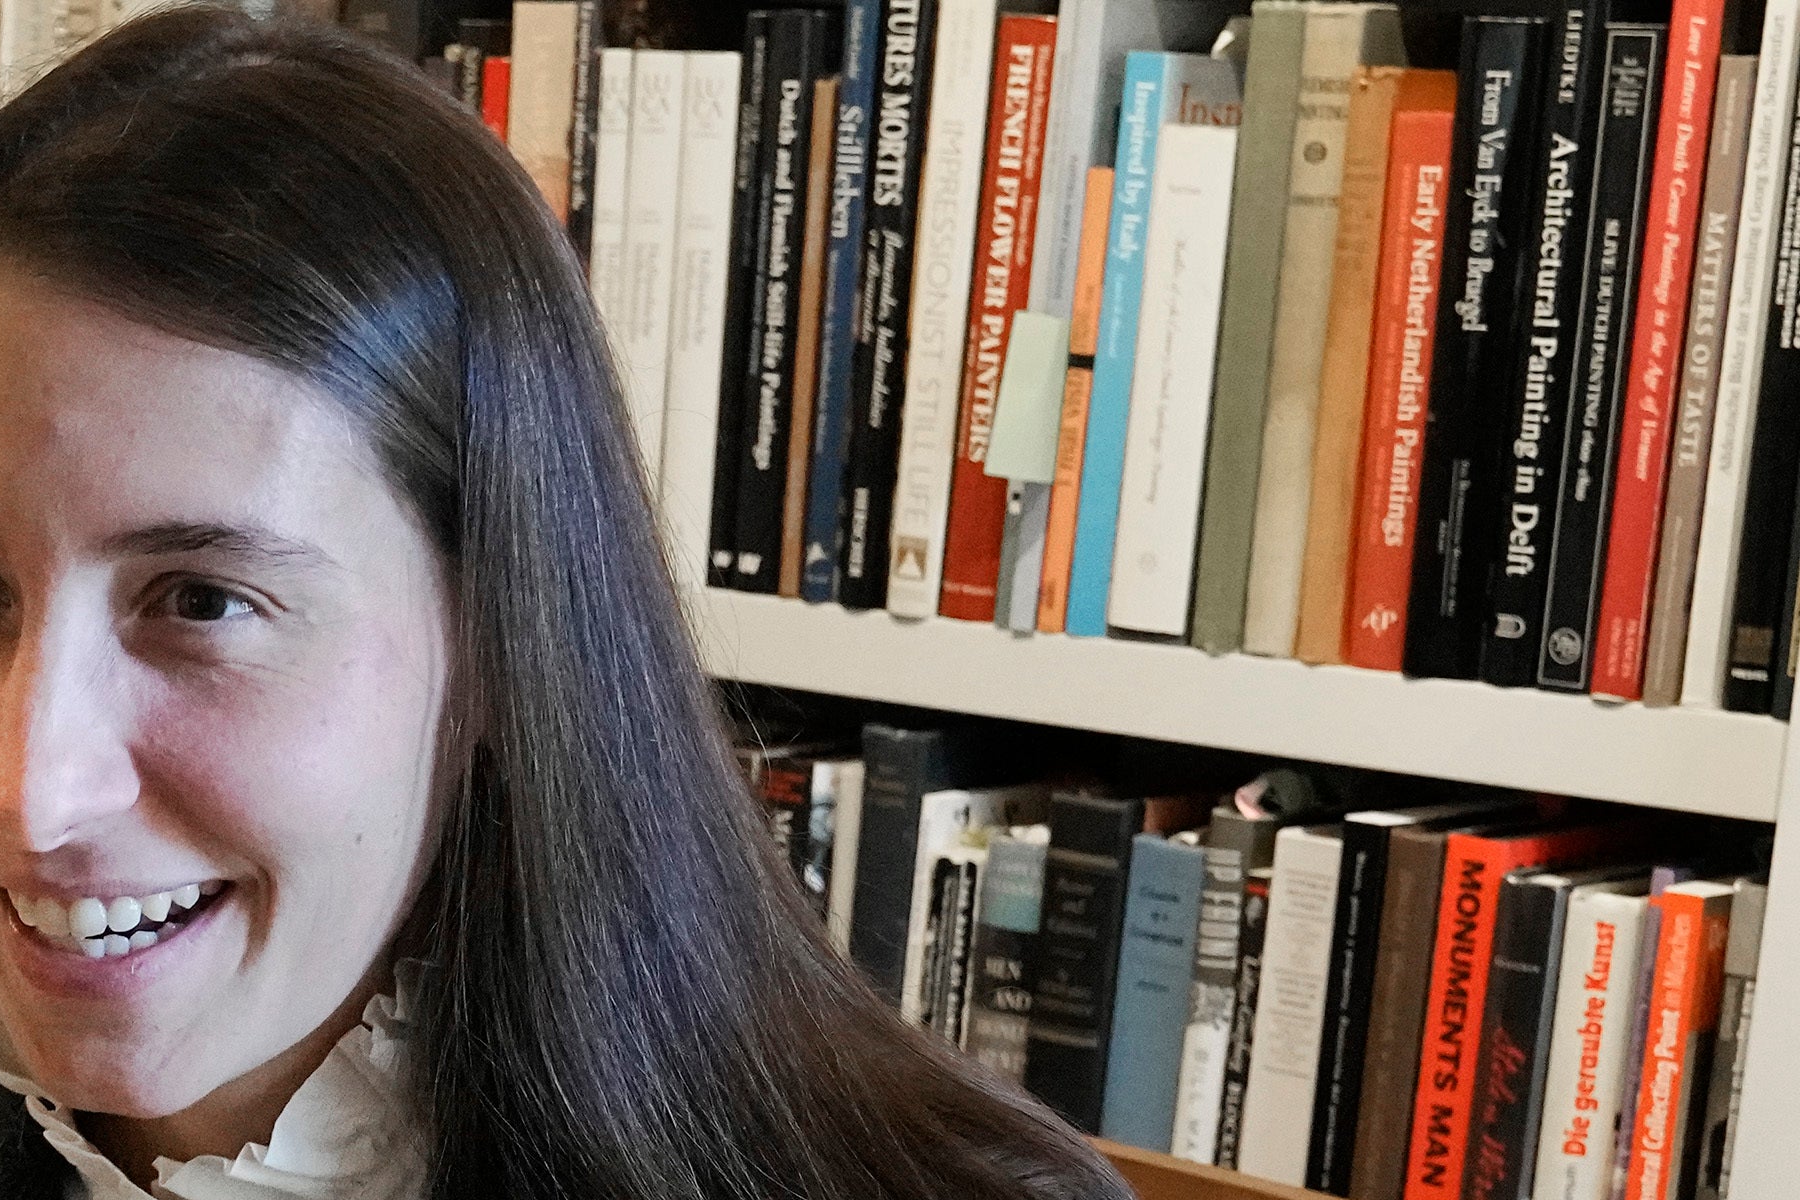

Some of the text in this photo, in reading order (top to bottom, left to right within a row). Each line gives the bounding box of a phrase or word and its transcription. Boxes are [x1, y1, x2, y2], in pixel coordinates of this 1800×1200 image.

[1684, 15, 1709, 56] Love
[869, 90, 915, 207] MORTES
[1127, 80, 1159, 177] Inspired
[1669, 121, 1696, 173] Dutch
[829, 103, 866, 238] Stillleben
[1116, 176, 1146, 207] by
[1408, 162, 1444, 232] Early
[1453, 68, 1511, 333] From Van Eyck to Bruegel
[1662, 175, 1689, 228] Genre
[748, 78, 804, 471] Dutch and Flemish Still-life Paintings
[965, 42, 1035, 463] FRENCH FLOWER PAINTERS
[1110, 210, 1142, 261] Italy
[1650, 230, 1683, 306] Paintings
[904, 118, 966, 527] IMPRESSIONIST STILL LIFE
[1392, 236, 1439, 423] Netherlandish
[1503, 9, 1584, 577] LIEDTKE Architectural Painting in Delft
[1591, 274, 1614, 341] DUTCH
[1651, 308, 1672, 328] in
[1640, 357, 1666, 392] Age
[1647, 328, 1670, 359] the
[1675, 210, 1729, 469] MATTERS OF TASTE
[1581, 341, 1608, 428] PAINTING
[1636, 393, 1662, 414] of
[1379, 425, 1420, 548] Paintings
[1632, 417, 1659, 483] Vermeer
[1419, 857, 1488, 1188] MONUMENTS MAN
[1558, 919, 1618, 1158] Die geraubte Kunst
[1650, 1006, 1681, 1060] Point
[1660, 989, 1683, 1008] in
[1638, 1058, 1680, 1152] Collecting
